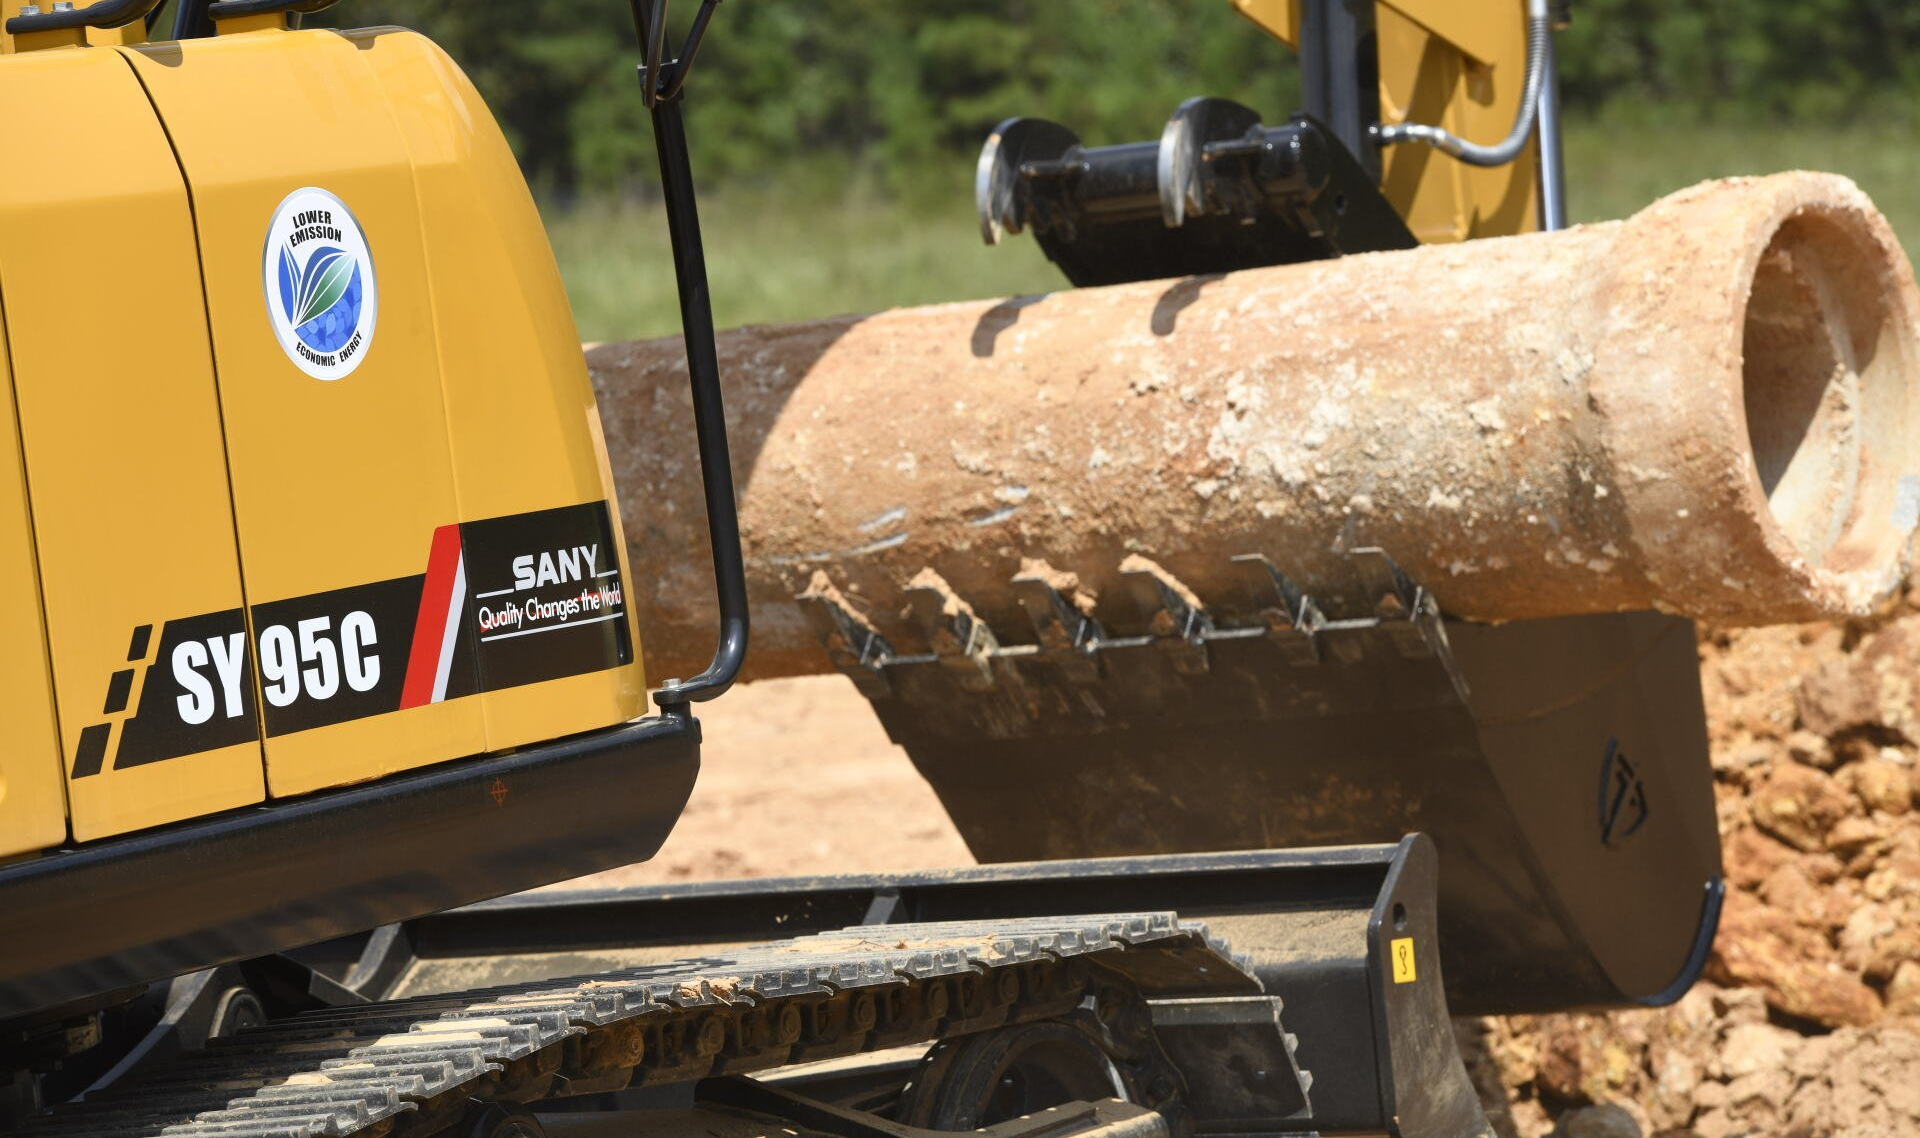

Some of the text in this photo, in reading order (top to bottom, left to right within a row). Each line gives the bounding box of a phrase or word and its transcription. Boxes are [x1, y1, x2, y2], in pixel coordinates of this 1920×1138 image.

[290, 226, 342, 247] EMISSION
[293, 210, 332, 229] LOWER
[296, 331, 362, 366] ECONOMIC ENERGY
[512, 544, 597, 591] SANY
[479, 582, 621, 629] Quality Changes the World
